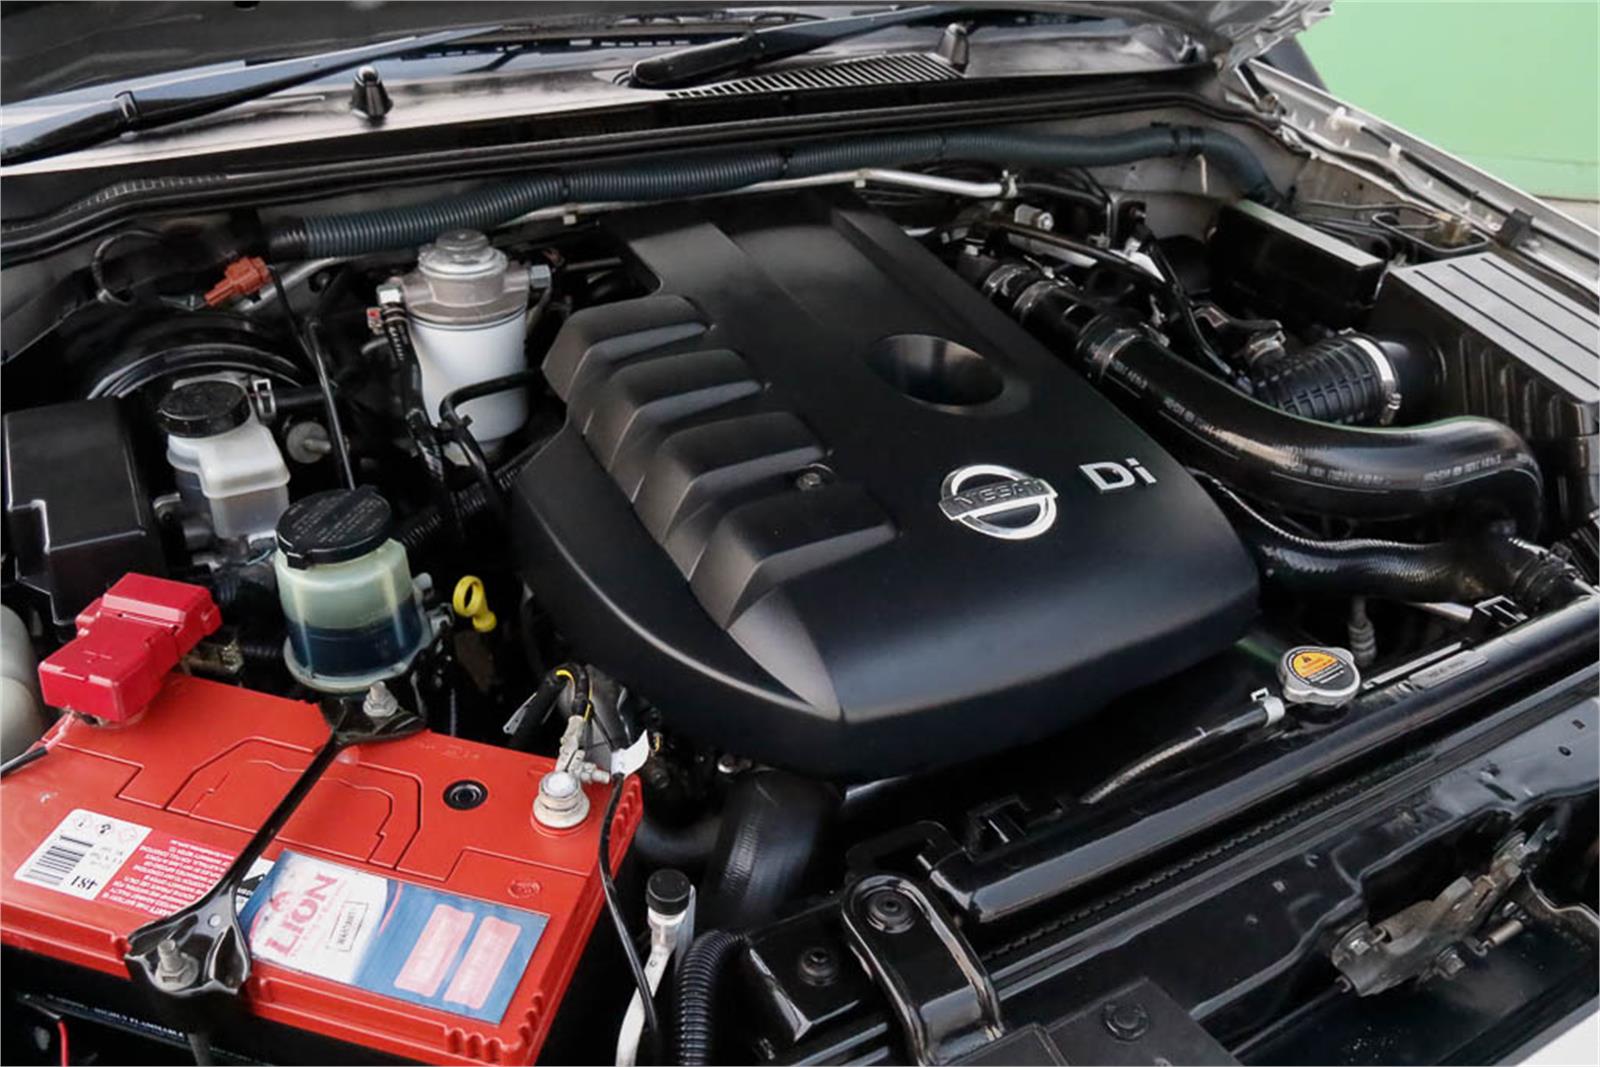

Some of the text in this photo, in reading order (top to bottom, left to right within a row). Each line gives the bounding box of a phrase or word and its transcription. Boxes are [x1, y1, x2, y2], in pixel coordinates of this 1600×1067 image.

[1079, 457, 1158, 493] Di
[953, 479, 1044, 509] NISSAN
[264, 873, 338, 957] LION
